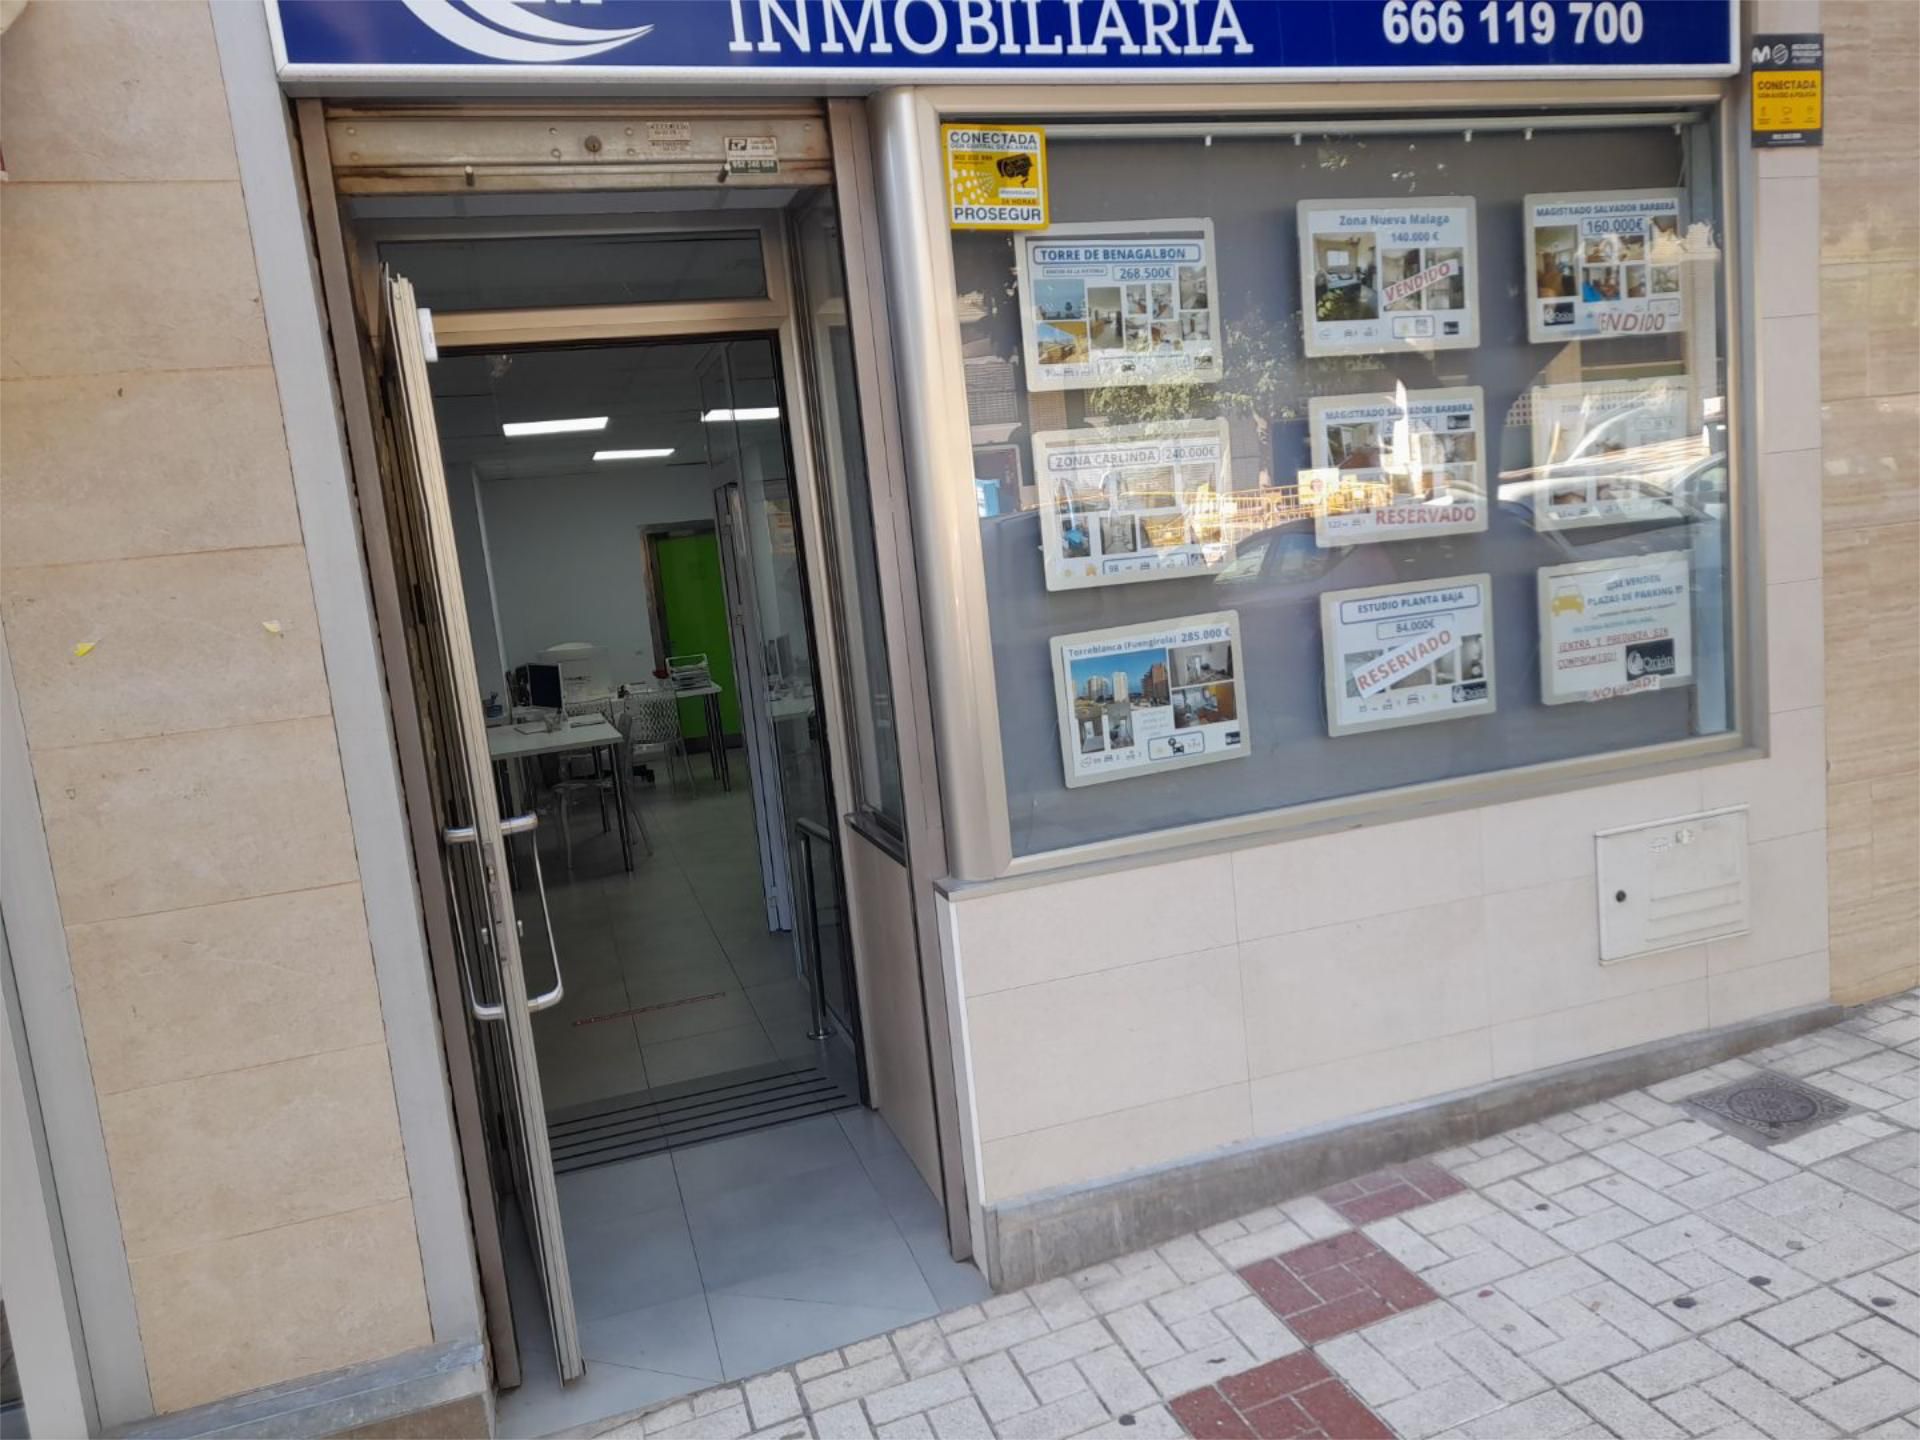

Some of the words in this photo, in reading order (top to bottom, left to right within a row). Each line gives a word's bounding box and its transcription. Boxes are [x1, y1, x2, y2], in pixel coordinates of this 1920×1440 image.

[728, 0, 1254, 55] INMOBILIARIA
[1382, 0, 1464, 44] 666
[1479, 1, 1555, 44] 119
[1569, 1, 1643, 44] 700
[1757, 80, 1817, 90] CONECTADA
[950, 131, 1037, 145] CONECTADA
[954, 207, 1041, 221] PROSEGUR
[1536, 206, 1592, 217] MAGISTRADO
[1593, 204, 1638, 214] SALVADOR
[1339, 215, 1367, 226] Zona
[1370, 215, 1407, 226] Nueva
[1586, 217, 1643, 233] 160.000€
[1391, 231, 1430, 243] 140.000
[1432, 231, 1440, 241] €
[1040, 249, 1081, 261] TORRE
[1084, 249, 1099, 260] DE
[1103, 248, 1185, 260] BENAGALBON
[1119, 267, 1172, 280] 268.500€
[1385, 262, 1451, 302] VENDIDO
[1599, 312, 1666, 331] ENDIDO
[1325, 409, 1384, 420] MAGISTRADO
[1387, 406, 1432, 417] SALADOR
[1055, 456, 1091, 469] ZONA
[1094, 450, 1157, 465] CARLINDA
[1376, 507, 1477, 526] RESERVADO
[1357, 600, 1399, 614] ESTUDIO
[1401, 595, 1439, 608] PLANTA
[1441, 592, 1464, 603] BAJA
[1587, 593, 1620, 606] PLAZAS
[1622, 592, 1633, 601] DE
[1634, 588, 1673, 600] PARKING
[1181, 628, 1222, 643] 285.000
[1068, 643, 1123, 658] Torreblanca
[1356, 630, 1451, 690] RESERVADO
